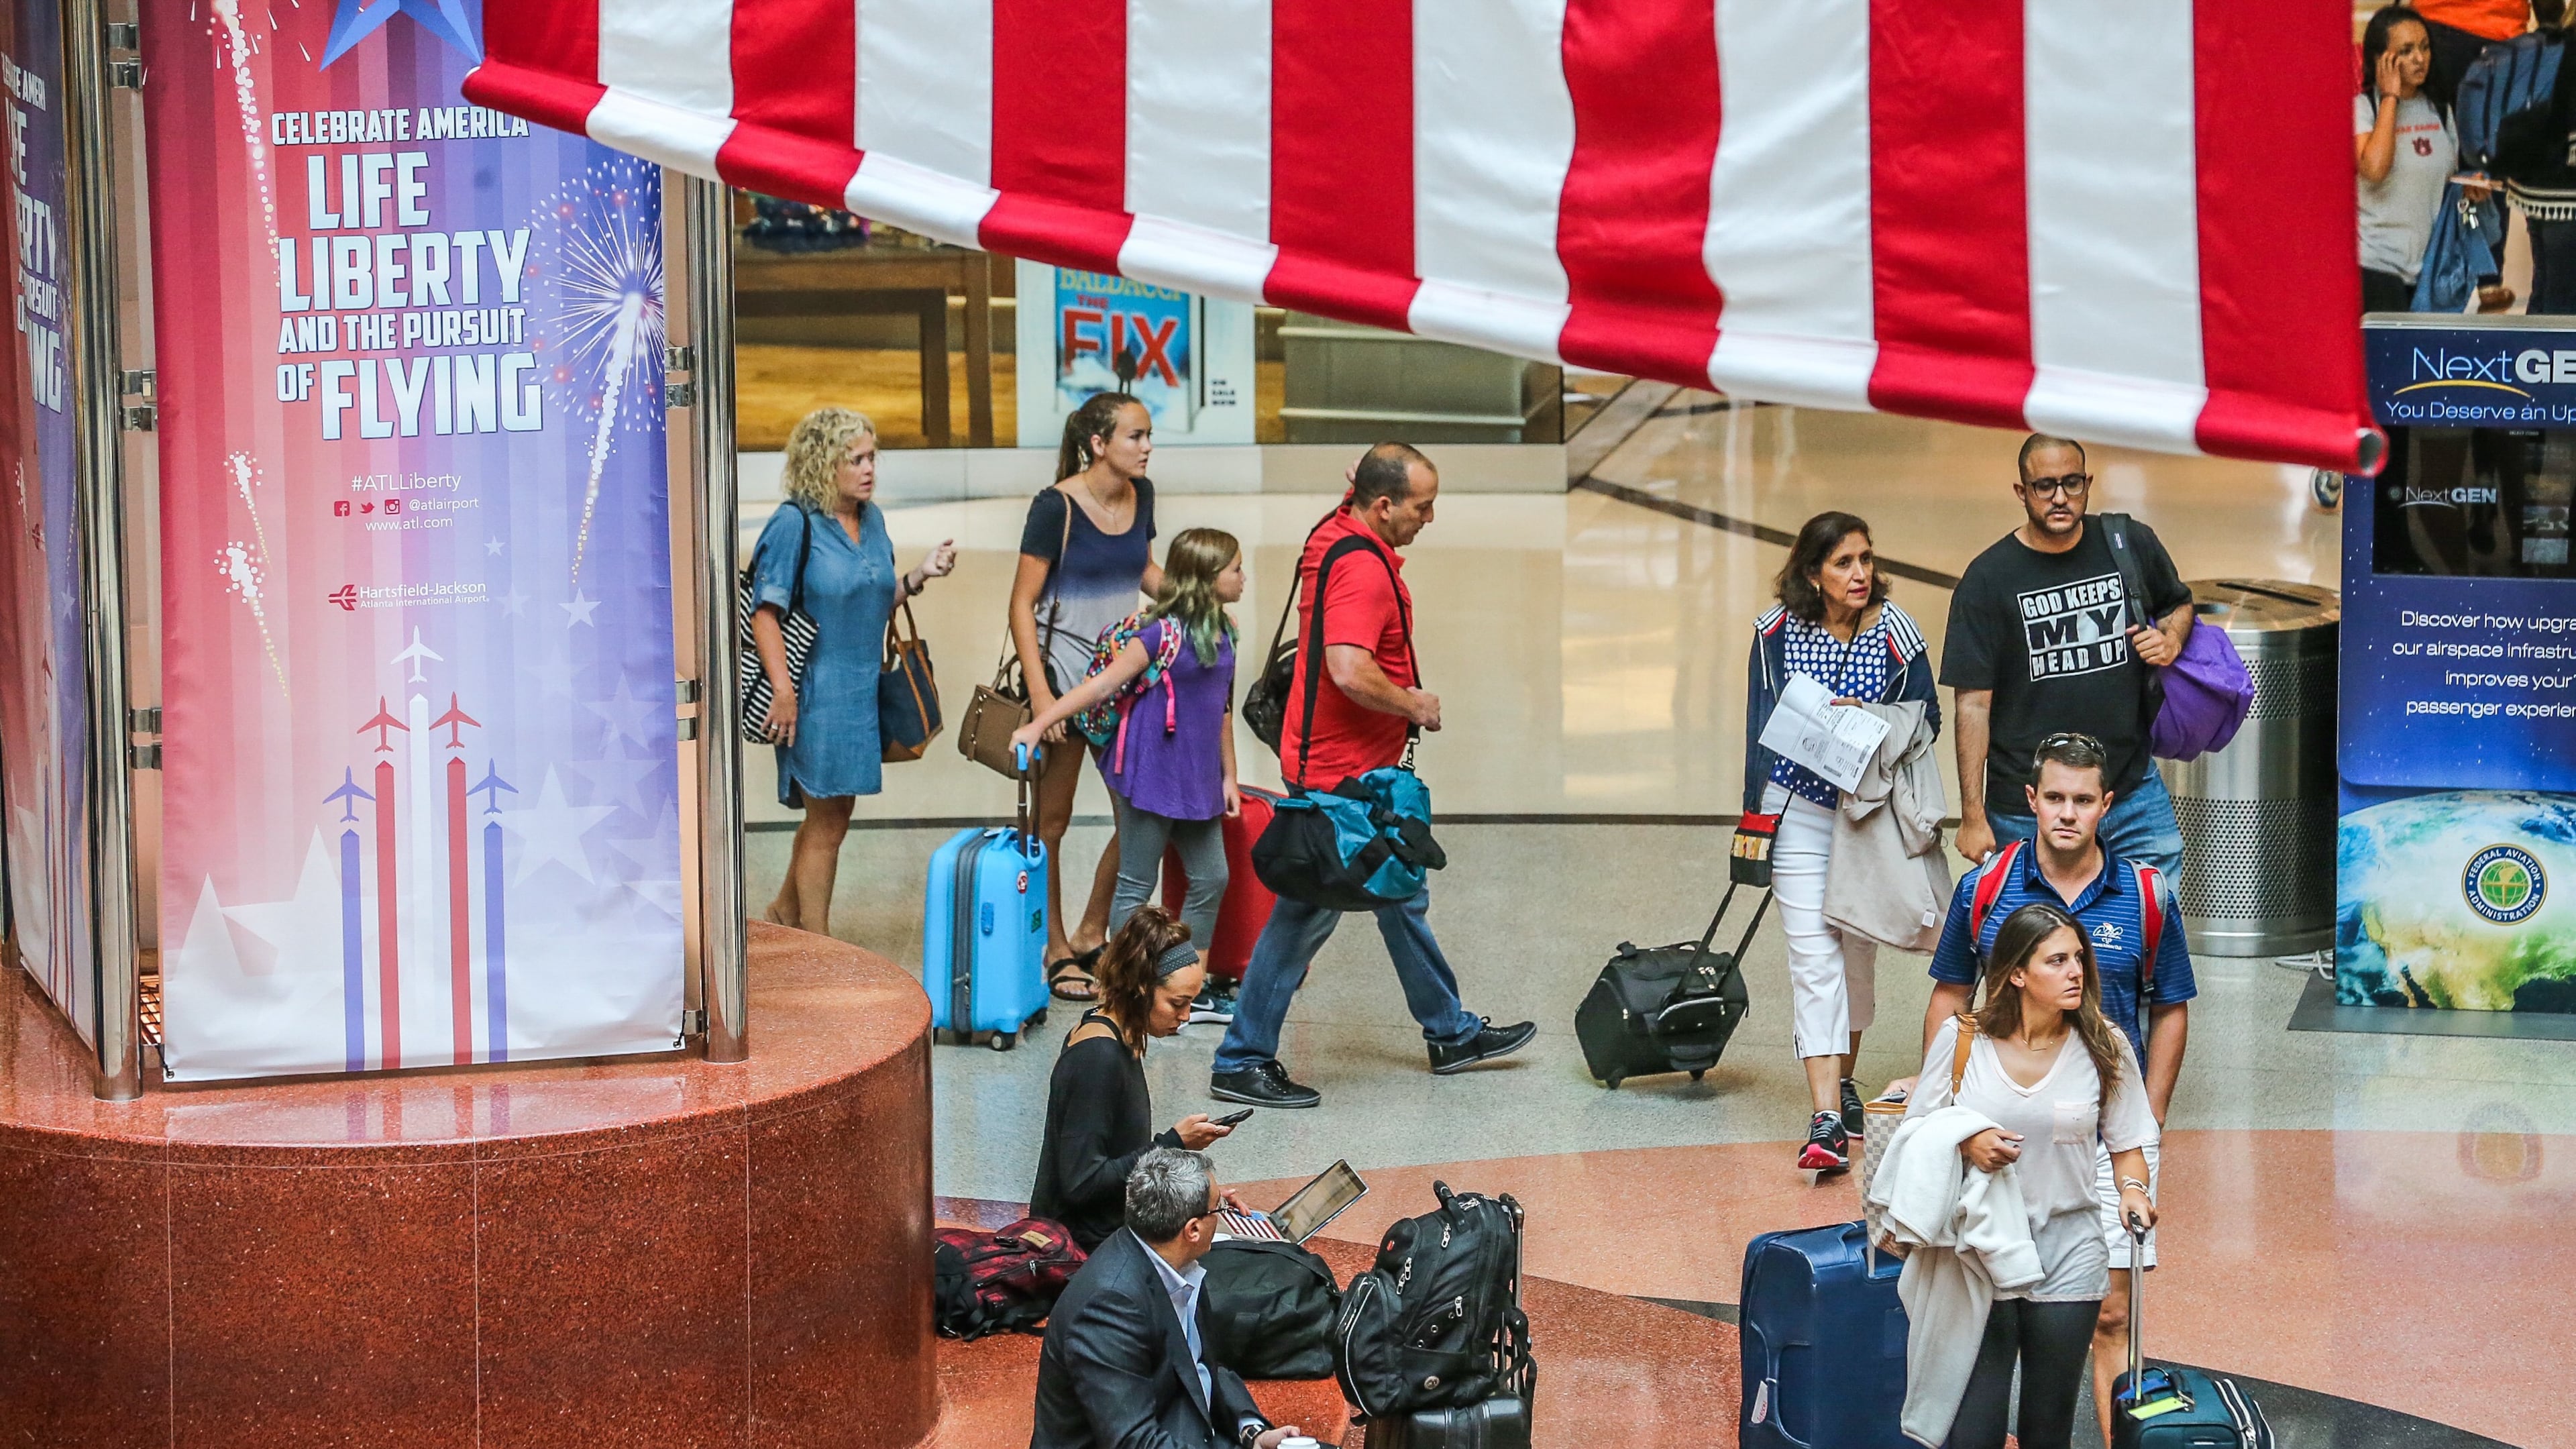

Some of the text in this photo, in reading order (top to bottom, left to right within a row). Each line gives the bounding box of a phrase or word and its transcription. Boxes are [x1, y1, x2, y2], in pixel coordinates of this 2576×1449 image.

[271, 108, 411, 145] CELEBRATE
[307, 152, 430, 230] LIFE
[278, 229, 531, 313] LIBERTY
[277, 308, 527, 354] AND THE PURSUIT
[1063, 308, 1180, 388] FIX
[276, 352, 543, 441] OF FLYING
[2385, 401, 2424, 419] You
[2430, 401, 2516, 420] Deserve
[2521, 407, 2546, 421] an
[351, 472, 462, 492] #ATLLiberty
[2406, 486, 2497, 503] NextGEN
[409, 498, 479, 513] @atlairport
[365, 517, 453, 531] www.atl.com
[360, 582, 486, 598] Hartsfield-Jackson
[360, 595, 486, 608] Atlanta International Airport
[2022, 578, 2122, 619] GOD KEEPS
[2027, 604, 2124, 650] MY
[2401, 610, 2481, 629] Discover
[2484, 613, 2524, 629] how
[2032, 639, 2124, 677] HEAD UP
[2392, 642, 2423, 656] our
[2426, 641, 2504, 659] airspace
[2445, 669, 2571, 691] improves your
[2406, 700, 2502, 718] passenger
[2469, 849, 2541, 881] FEDERAL AVIATION
[2469, 890, 2540, 921] ADMINISTRATION
